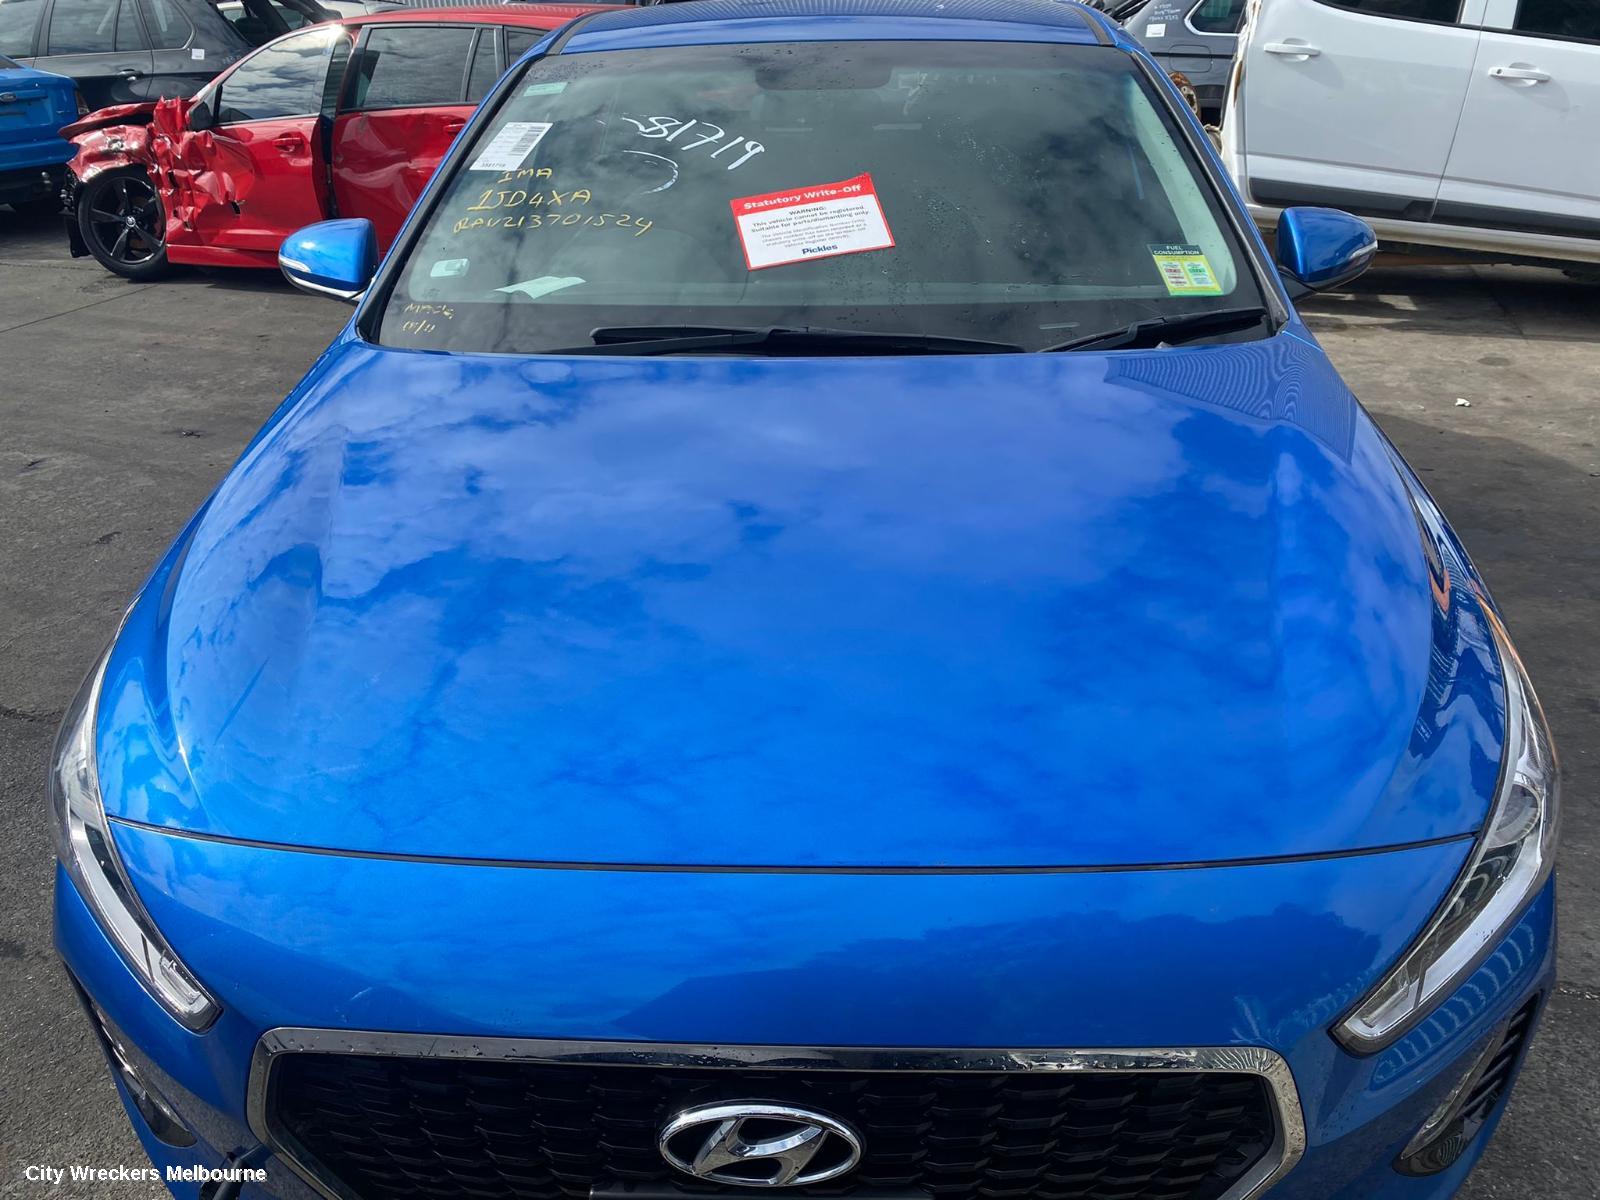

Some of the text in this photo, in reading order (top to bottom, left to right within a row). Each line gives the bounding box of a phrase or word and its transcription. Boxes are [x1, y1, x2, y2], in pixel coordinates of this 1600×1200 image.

[744, 184, 862, 209] Statutory Write-Off
[768, 216, 792, 225] vehicle
[794, 212, 818, 220] cannot
[802, 244, 838, 254] Pickles
